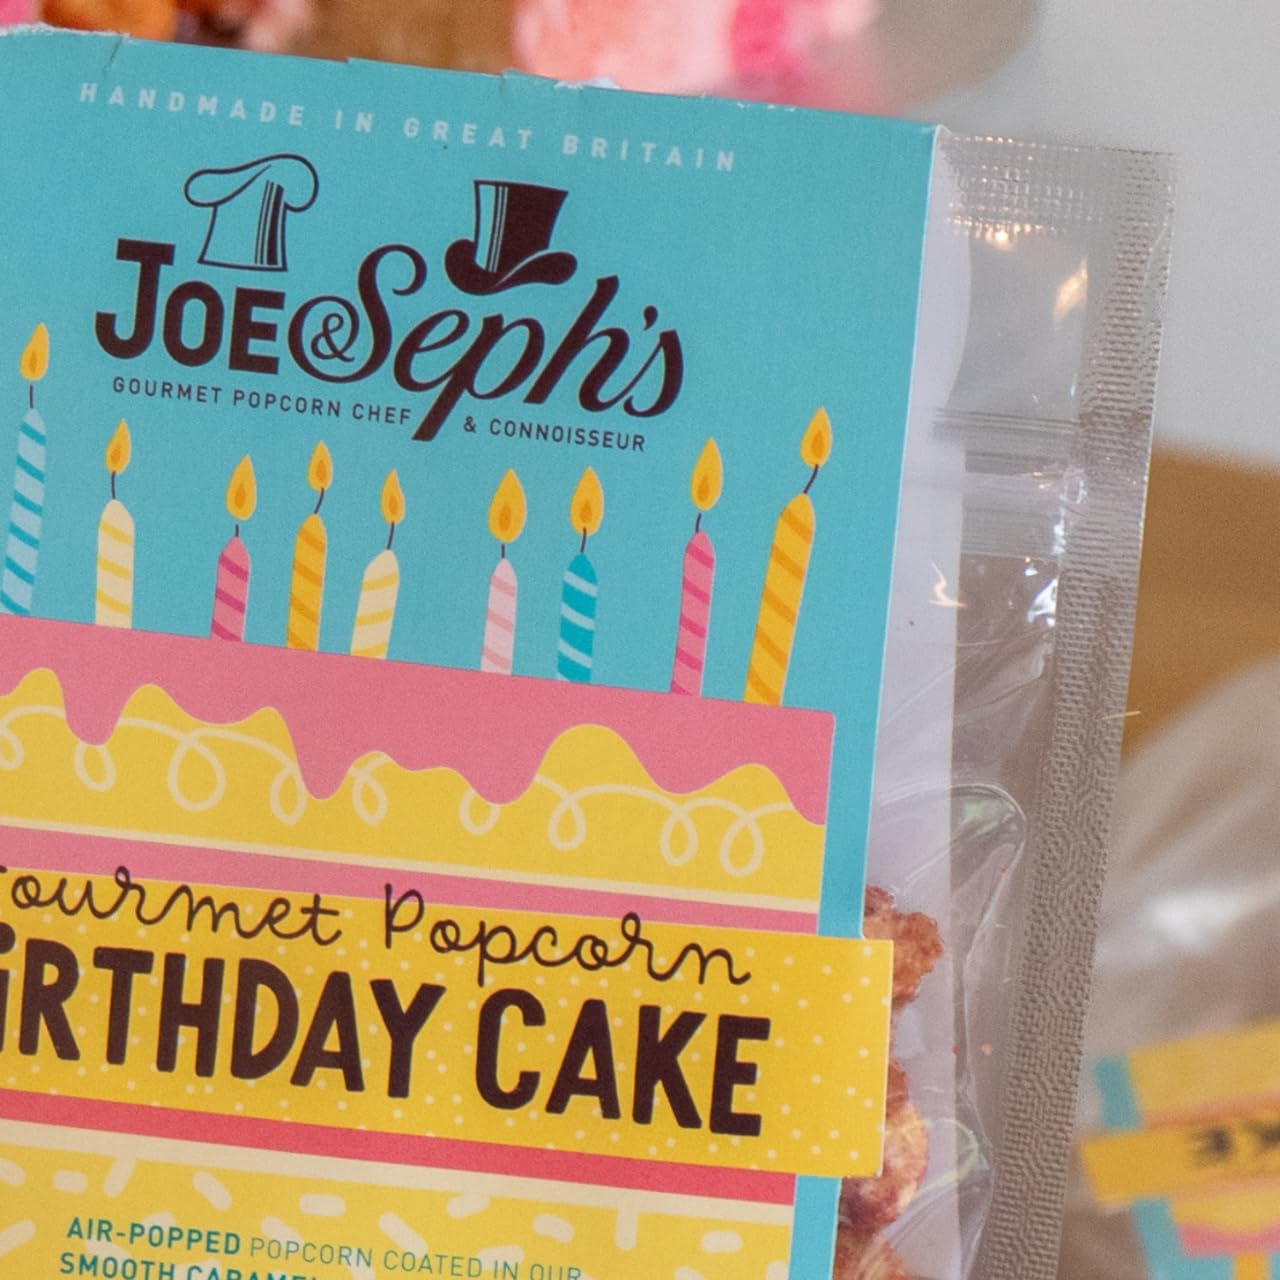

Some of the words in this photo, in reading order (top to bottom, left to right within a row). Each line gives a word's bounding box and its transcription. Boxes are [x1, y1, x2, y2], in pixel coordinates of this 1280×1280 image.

[80, 83, 305, 125] HANDMADE
[335, 111, 373, 134] IN
[404, 116, 532, 151] GREAT
[563, 135, 736, 172] BRITAIN
[113, 376, 222, 404] GOURMET
[233, 390, 341, 417] POPCORN
[352, 404, 412, 425] CHEF
[464, 416, 477, 433] &
[490, 419, 646, 451] CONNOISSEUR
[384, 884, 751, 986] Popcorn
[474, 989, 771, 1137] CAKE
[67, 1217, 240, 1255] AIR-POPPED
[250, 1238, 372, 1268] POPCORN
[384, 1250, 483, 1279] COATED
[494, 1262, 518, 1280] IN
